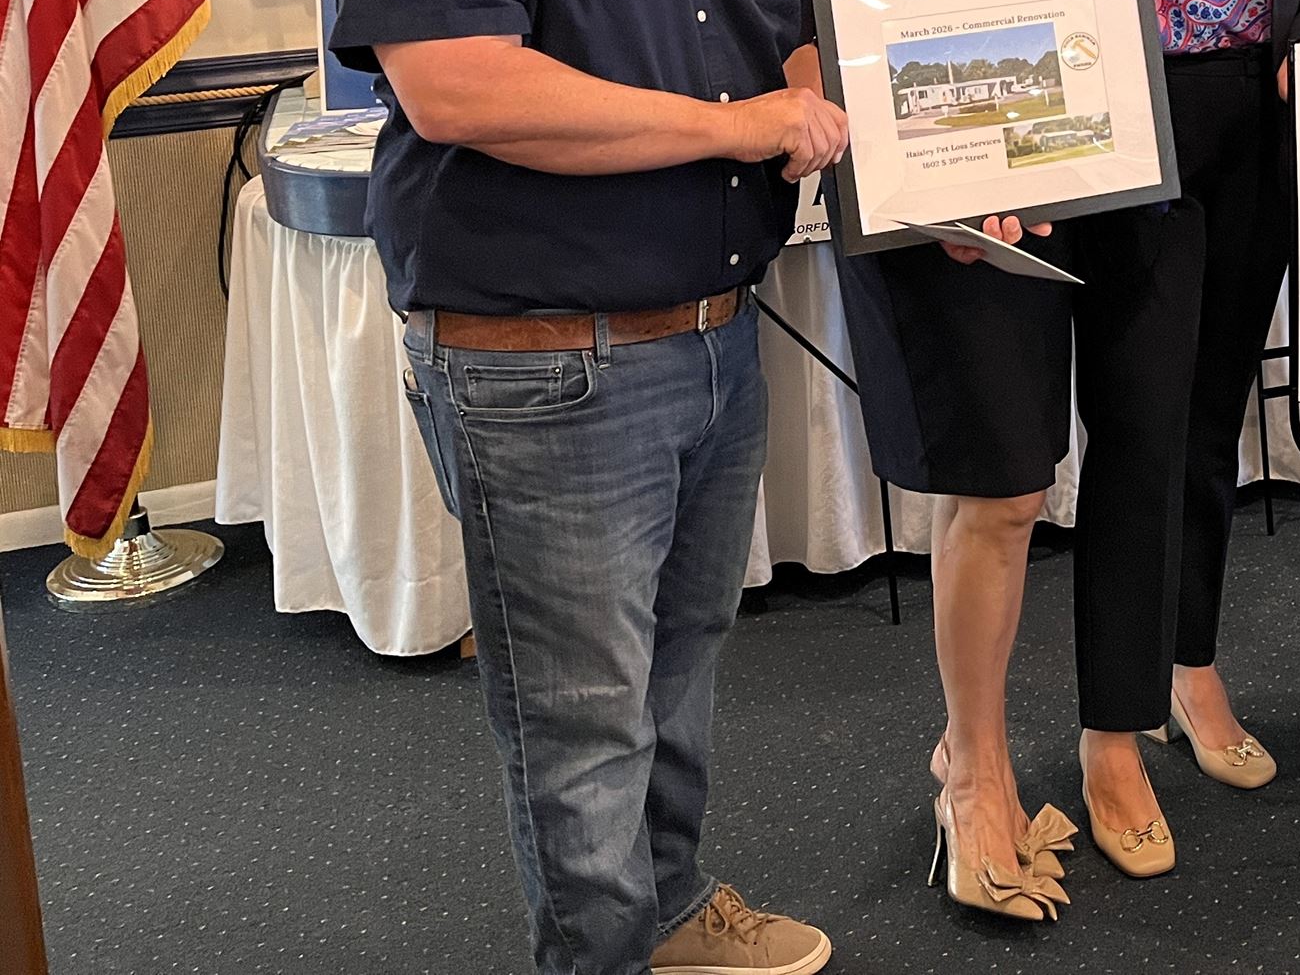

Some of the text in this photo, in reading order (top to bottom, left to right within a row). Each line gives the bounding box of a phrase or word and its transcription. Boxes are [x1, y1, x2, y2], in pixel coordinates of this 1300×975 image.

[900, 27, 930, 39] March
[931, 24, 953, 35] 2026
[962, 15, 1015, 31] Commercial
[1017, 9, 1066, 23] Renovation
[905, 138, 1002, 158] Haisley Pet Loss Services
[965, 152, 989, 163] Street
